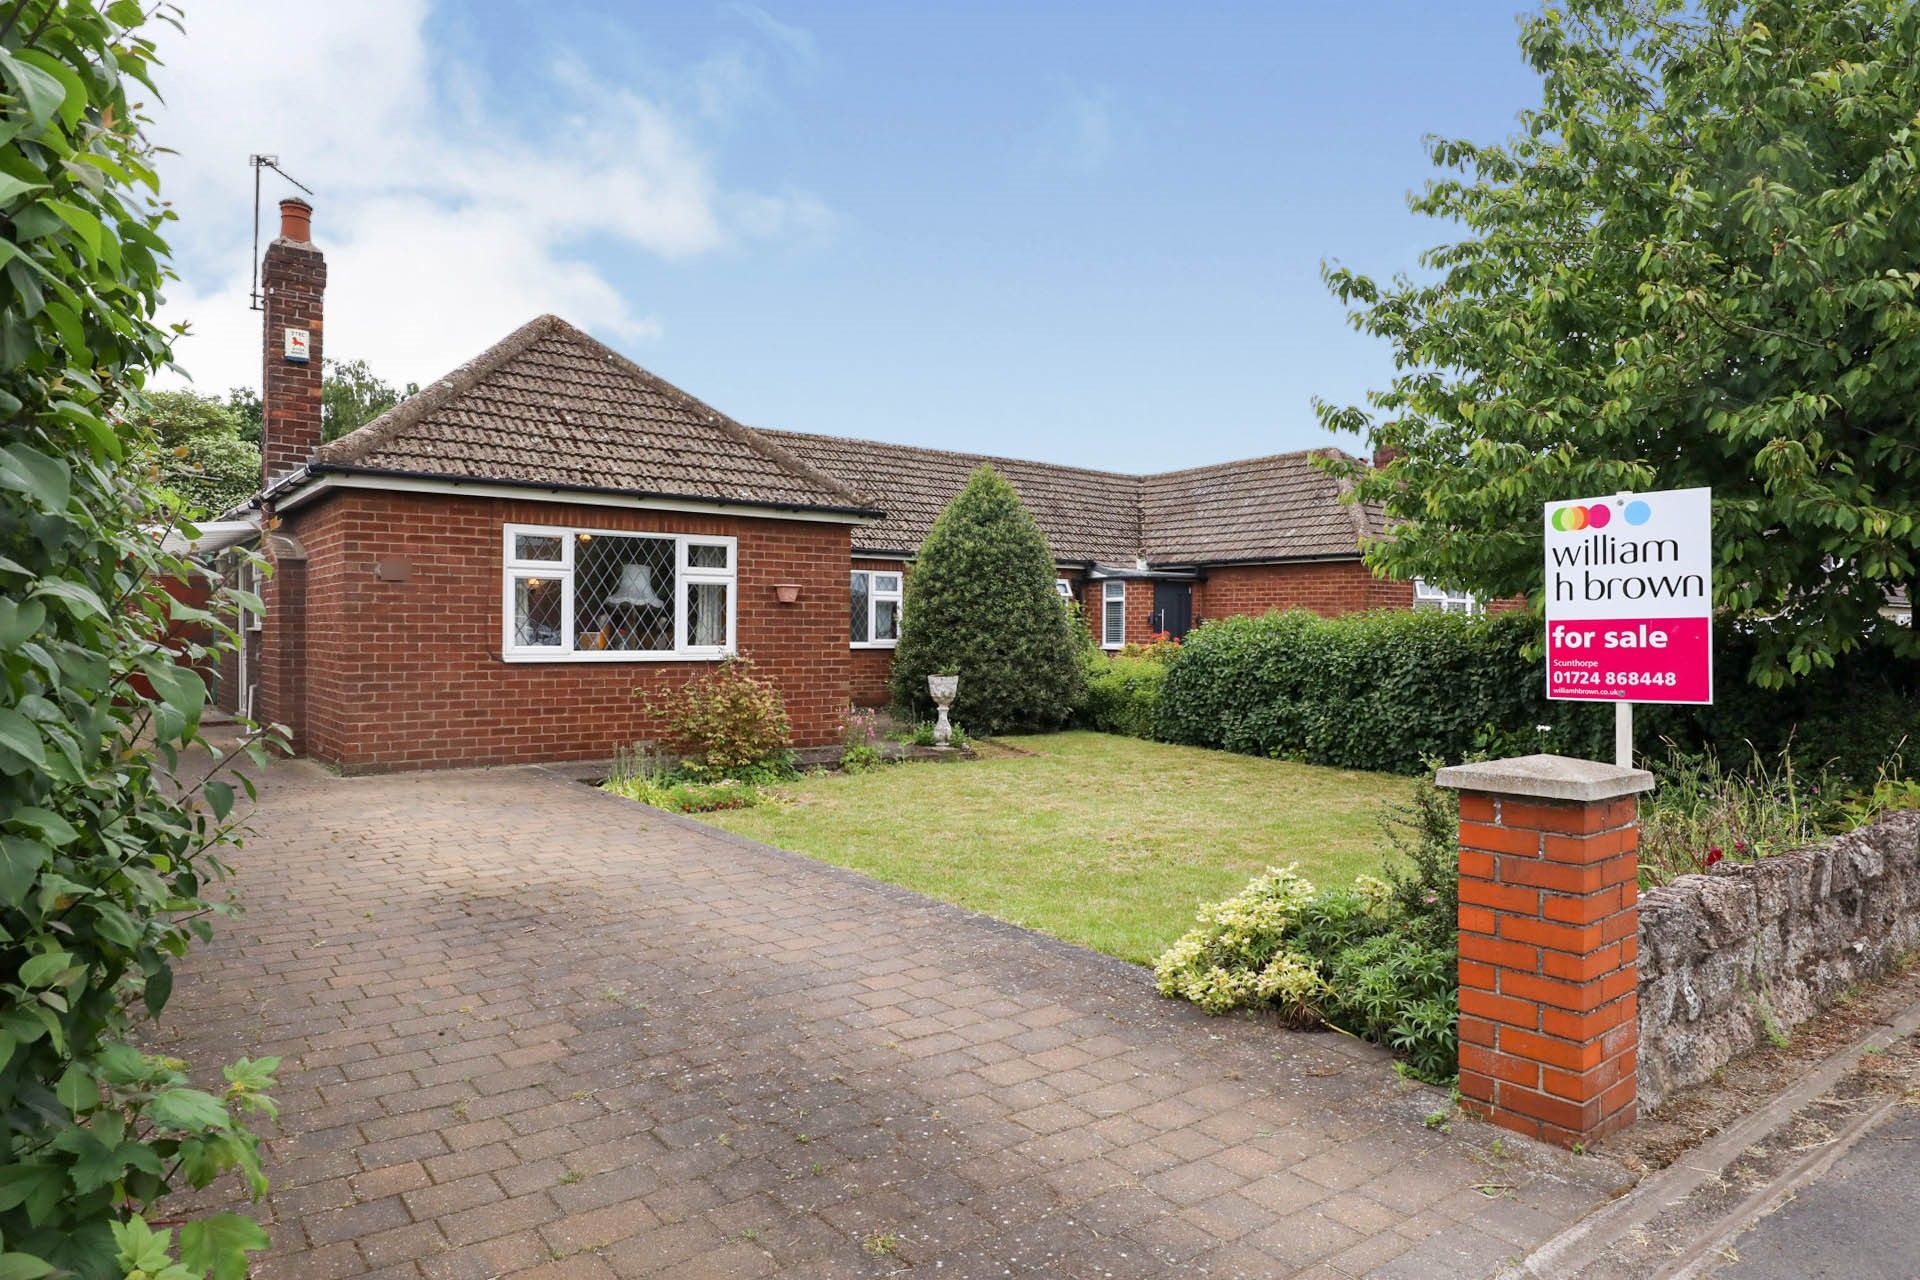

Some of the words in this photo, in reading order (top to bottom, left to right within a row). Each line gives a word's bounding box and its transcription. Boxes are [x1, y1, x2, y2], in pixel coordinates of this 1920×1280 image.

[1552, 534, 1679, 567] william
[1556, 572, 1574, 601] h
[1585, 570, 1704, 601] brown
[1552, 625, 1596, 648] for
[1604, 624, 1668, 648] sale
[1553, 659, 1599, 668] Scunthorpe
[1553, 671, 1600, 684] 01724
[1605, 672, 1677, 686] 868448
[1553, 687, 1618, 696] williamhbrown.co.uk
